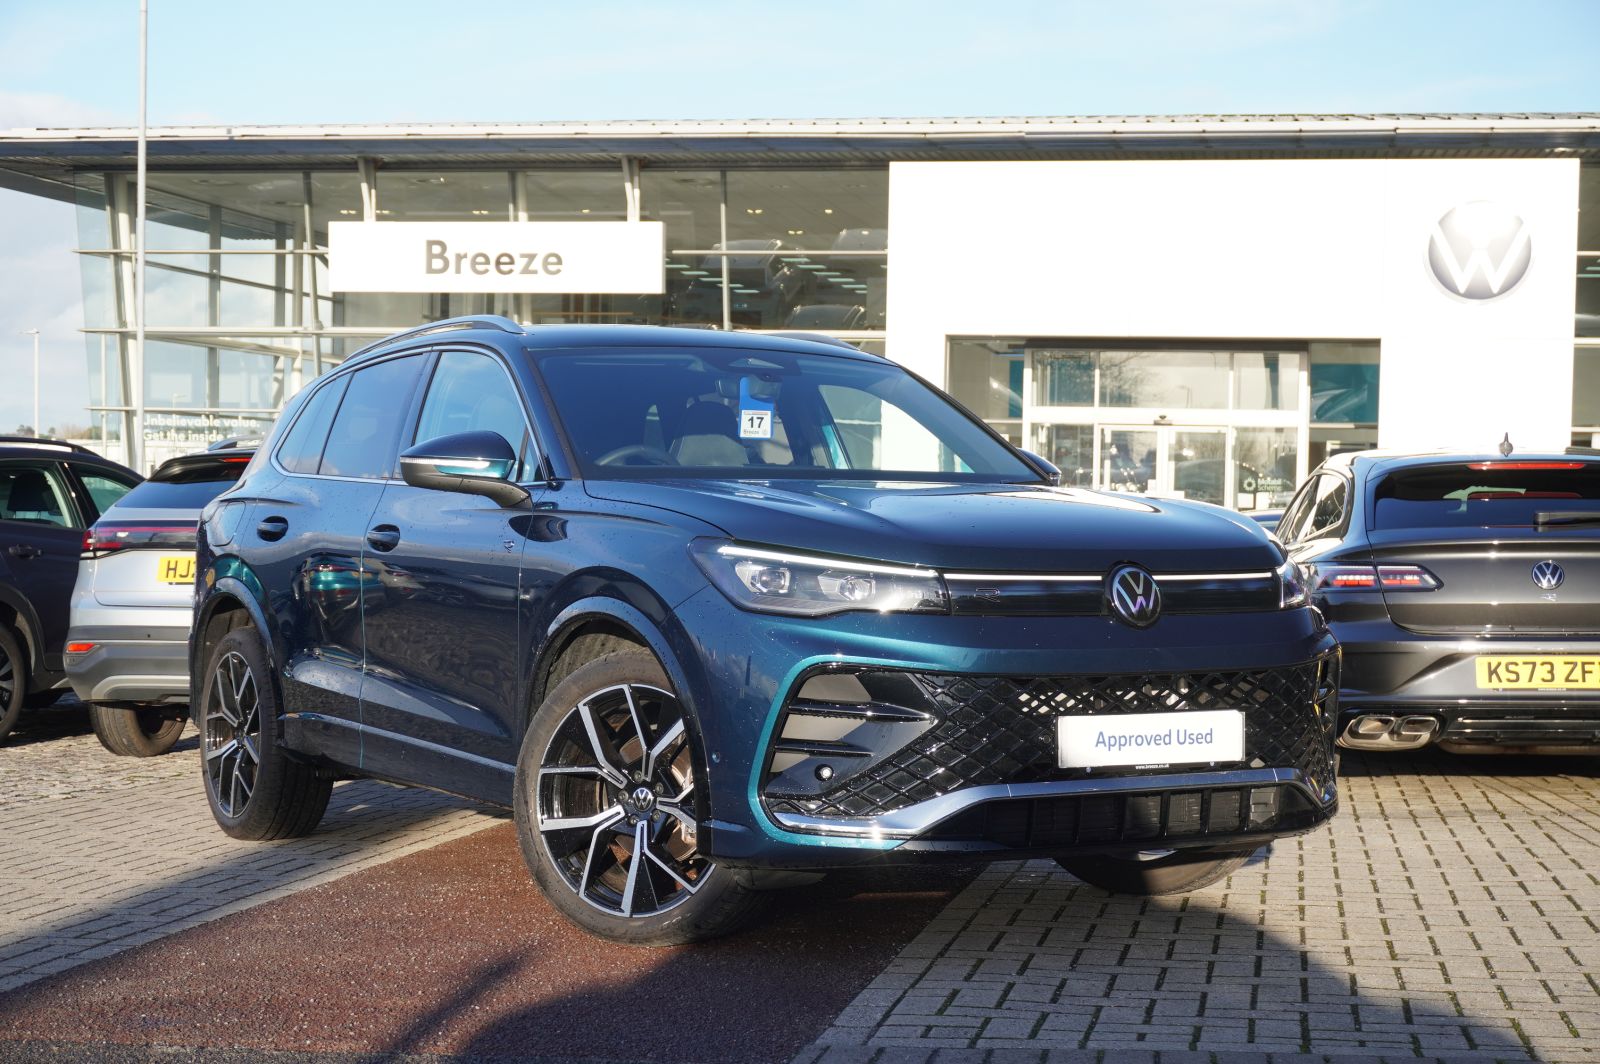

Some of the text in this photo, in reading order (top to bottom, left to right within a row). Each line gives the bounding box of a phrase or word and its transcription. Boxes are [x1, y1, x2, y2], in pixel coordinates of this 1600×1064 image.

[425, 239, 563, 276] Breeze
[223, 415, 260, 428] value.
[747, 416, 764, 429] 17
[143, 428, 164, 441] Get
[167, 428, 186, 441] the
[188, 430, 224, 442] inside
[1487, 661, 1600, 684] KS73 ZF
[1094, 727, 1213, 752] Approved Used
